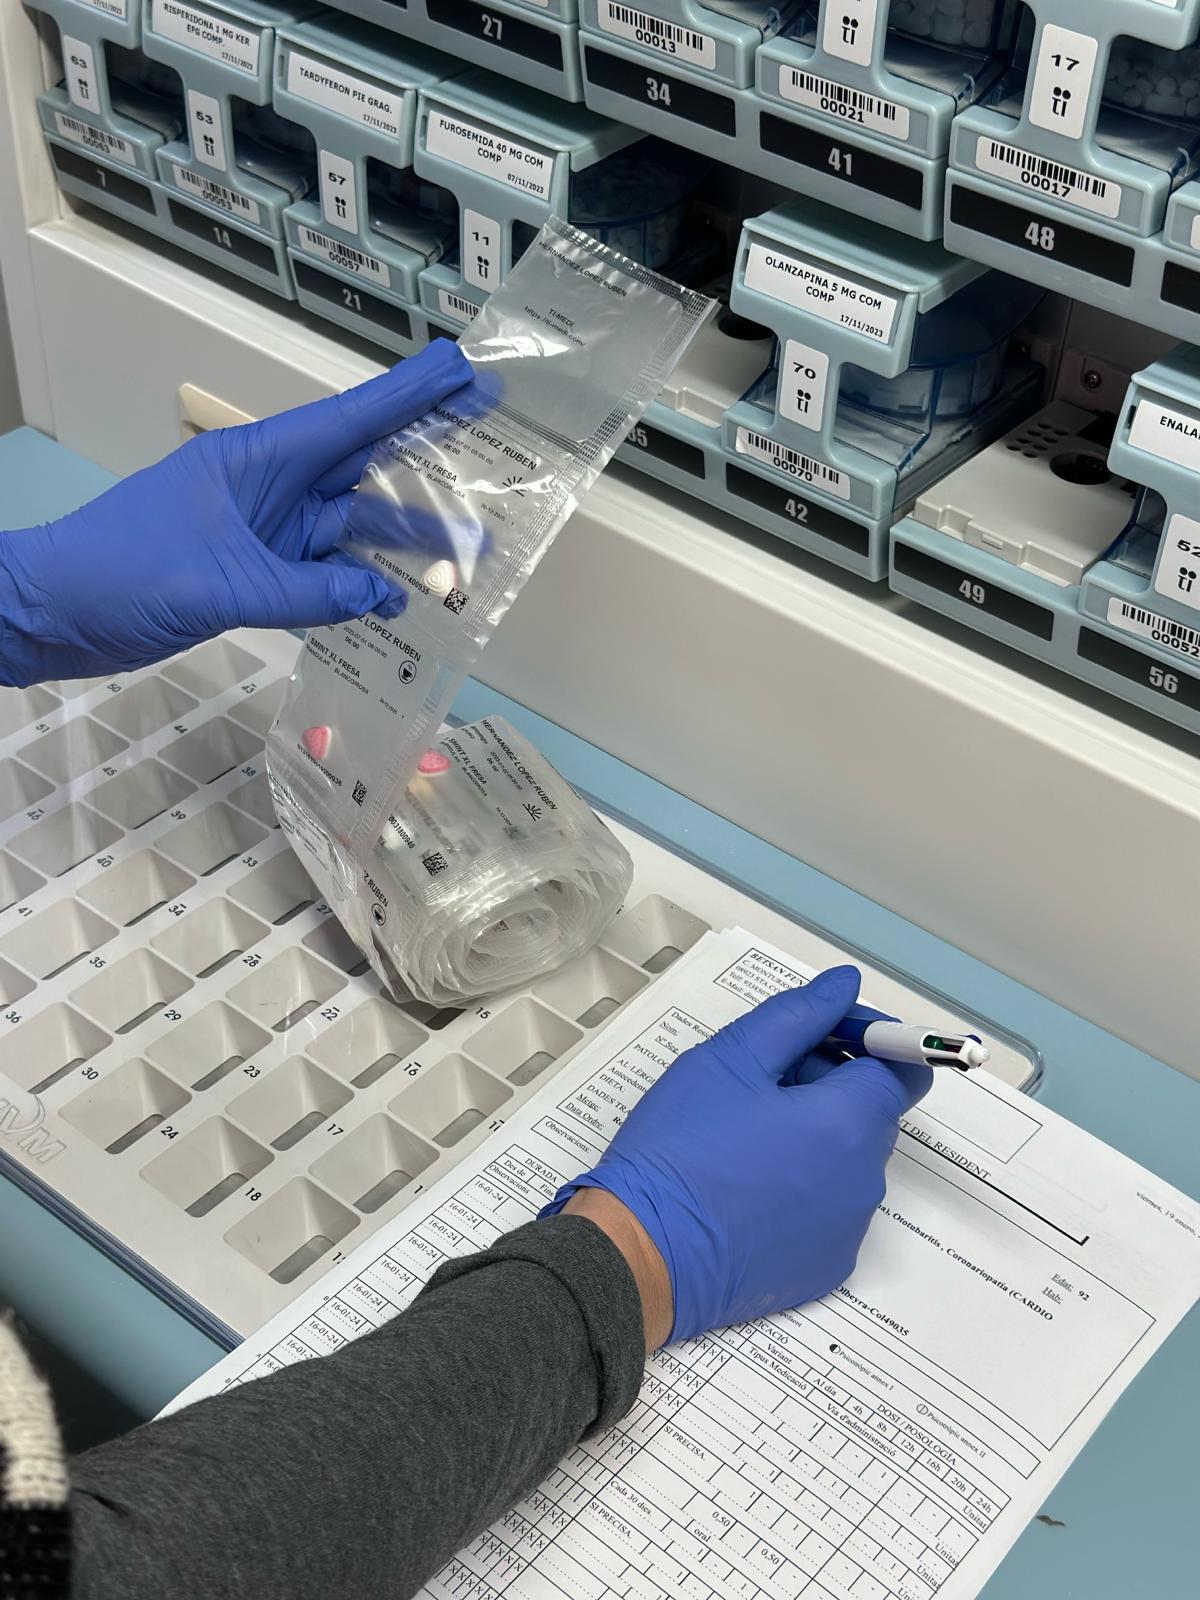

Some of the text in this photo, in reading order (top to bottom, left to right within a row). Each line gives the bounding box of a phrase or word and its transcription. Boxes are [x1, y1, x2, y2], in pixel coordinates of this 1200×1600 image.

[163, 3, 250, 46] RISPERIDONA 1 MG KER
[186, 23, 200, 37] EFG
[481, 13, 503, 41] 27
[635, 28, 677, 54] 00013
[221, 51, 253, 71] 17/11/2023
[1051, 54, 1080, 72] 17
[299, 67, 392, 114] TARDYFERON PIE GRAG.
[645, 76, 672, 106] 34
[196, 111, 214, 125] 53
[820, 97, 865, 124] 00021
[362, 113, 398, 134] 17/11/2023
[439, 119, 544, 169] FUROSEMIDA 40 MG COM
[476, 147, 502, 164] COMP
[827, 146, 853, 176] 41
[327, 171, 347, 186] 57
[507, 173, 545, 195] 07/11/2023
[1020, 170, 1072, 198] 00017
[202, 189, 233, 211] 00053
[212, 226, 232, 249] 14
[471, 231, 490, 246] 11
[1024, 221, 1056, 251] 48
[328, 251, 361, 273] 00057
[538, 240, 627, 297] HERNANDEZ LOPEZ RUBEN
[765, 256, 882, 310] OLANZAPINA 5 MG COM
[805, 285, 835, 303] COMP
[341, 288, 362, 312] 21
[839, 314, 884, 338] 17/11/2023
[792, 361, 817, 380] 70
[430, 406, 537, 471] NANDEZ LOPEZ RUBEN
[1159, 415, 1200, 441] ENALA
[398, 444, 458, 483] SMINT XL FRESA
[772, 456, 813, 483] 00070
[784, 498, 809, 524] 42
[1176, 539, 1200, 558] 52
[958, 579, 985, 604] 49
[364, 617, 422, 662] LOPEZ RUBEN
[1151, 630, 1200, 658] 00052
[310, 637, 361, 679] SMINT XL FRESA
[106, 682, 122, 693] 50
[1149, 665, 1179, 694] 56
[35, 723, 50, 733] 51
[173, 724, 189, 735] 44
[102, 766, 118, 777] 45
[241, 766, 257, 777] 38
[469, 765, 488, 785] FRESA
[481, 719, 518, 761] HERNANDEZ
[514, 761, 537, 786] LOPEZ
[533, 785, 559, 811] RUBEN
[170, 810, 187, 821] 39
[242, 856, 259, 868] 33
[367, 878, 389, 908] RUBEN
[17, 906, 33, 918] 41
[316, 904, 333, 915] 27
[89, 956, 107, 969] 35
[749, 952, 808, 987] BETSAN FUN
[5, 1010, 22, 1024] 36
[163, 1009, 182, 1022] 29
[320, 1007, 339, 1021] 22
[474, 1006, 490, 1020] 15
[671, 1011, 692, 1028] Dades
[659, 1020, 680, 1037] Nom:
[633, 1043, 671, 1069] PATOLOG
[81, 1066, 99, 1081] 30
[243, 1065, 262, 1078] 23
[402, 1062, 420, 1077] 16
[576, 1093, 602, 1112] Metge:
[586, 1084, 616, 1105] DADES
[565, 1101, 605, 1131] Data Ordre:
[160, 1125, 180, 1140] 24
[327, 1123, 345, 1137] 17
[545, 1120, 592, 1153] Observacions:
[910, 1126, 992, 1180] DEL RESIDENT
[503, 1159, 527, 1177] Des de
[524, 1157, 557, 1183] DURADA
[475, 1180, 503, 1201] 16-01-24
[489, 1164, 530, 1195] Observacions
[539, 1183, 554, 1197] Fins
[244, 1187, 262, 1202] 18
[449, 1202, 478, 1224] 16-01-24
[1136, 1191, 1196, 1236] viernes, 19 enero,
[428, 1219, 459, 1241] 16-01-24
[408, 1236, 438, 1259] 16-01-24
[380, 1259, 411, 1282] 16-01-24
[892, 1212, 1054, 1322] Ototubaritis Coronariopatía (CARDIO
[353, 1282, 383, 1307] 16-01-24
[1041, 1286, 1064, 1305] Hab:
[1051, 1273, 1090, 1302] Edat: 92
[331, 1301, 361, 1326] 16-01-24
[309, 1320, 340, 1345] 16-01-24
[766, 1343, 793, 1365] Variant
[749, 1346, 807, 1391] Tipus Medicació
[870, 1373, 889, 1388] annex
[852, 1404, 864, 1415] 4h
[663, 1425, 673, 1435] SI
[839, 1413, 896, 1458] d'administració
[876, 1422, 888, 1433] 8h
[876, 1404, 958, 1467] DOSI POSOLOGÍA
[927, 1411, 980, 1454] Psicotròpic annex
[900, 1439, 916, 1453] 12h
[926, 1457, 941, 1472] 16h
[610, 1479, 638, 1505] Cada 30
[950, 1478, 967, 1493] 20h
[588, 1501, 600, 1512] SI
[975, 1497, 992, 1514] 24h
[711, 1510, 732, 1528] 0,50
[962, 1505, 988, 1531] Unitat
[694, 1527, 712, 1543] oral
[761, 1548, 781, 1566] 0,50
[934, 1542, 960, 1568] Unitat
[916, 1565, 942, 1590] Unitat
